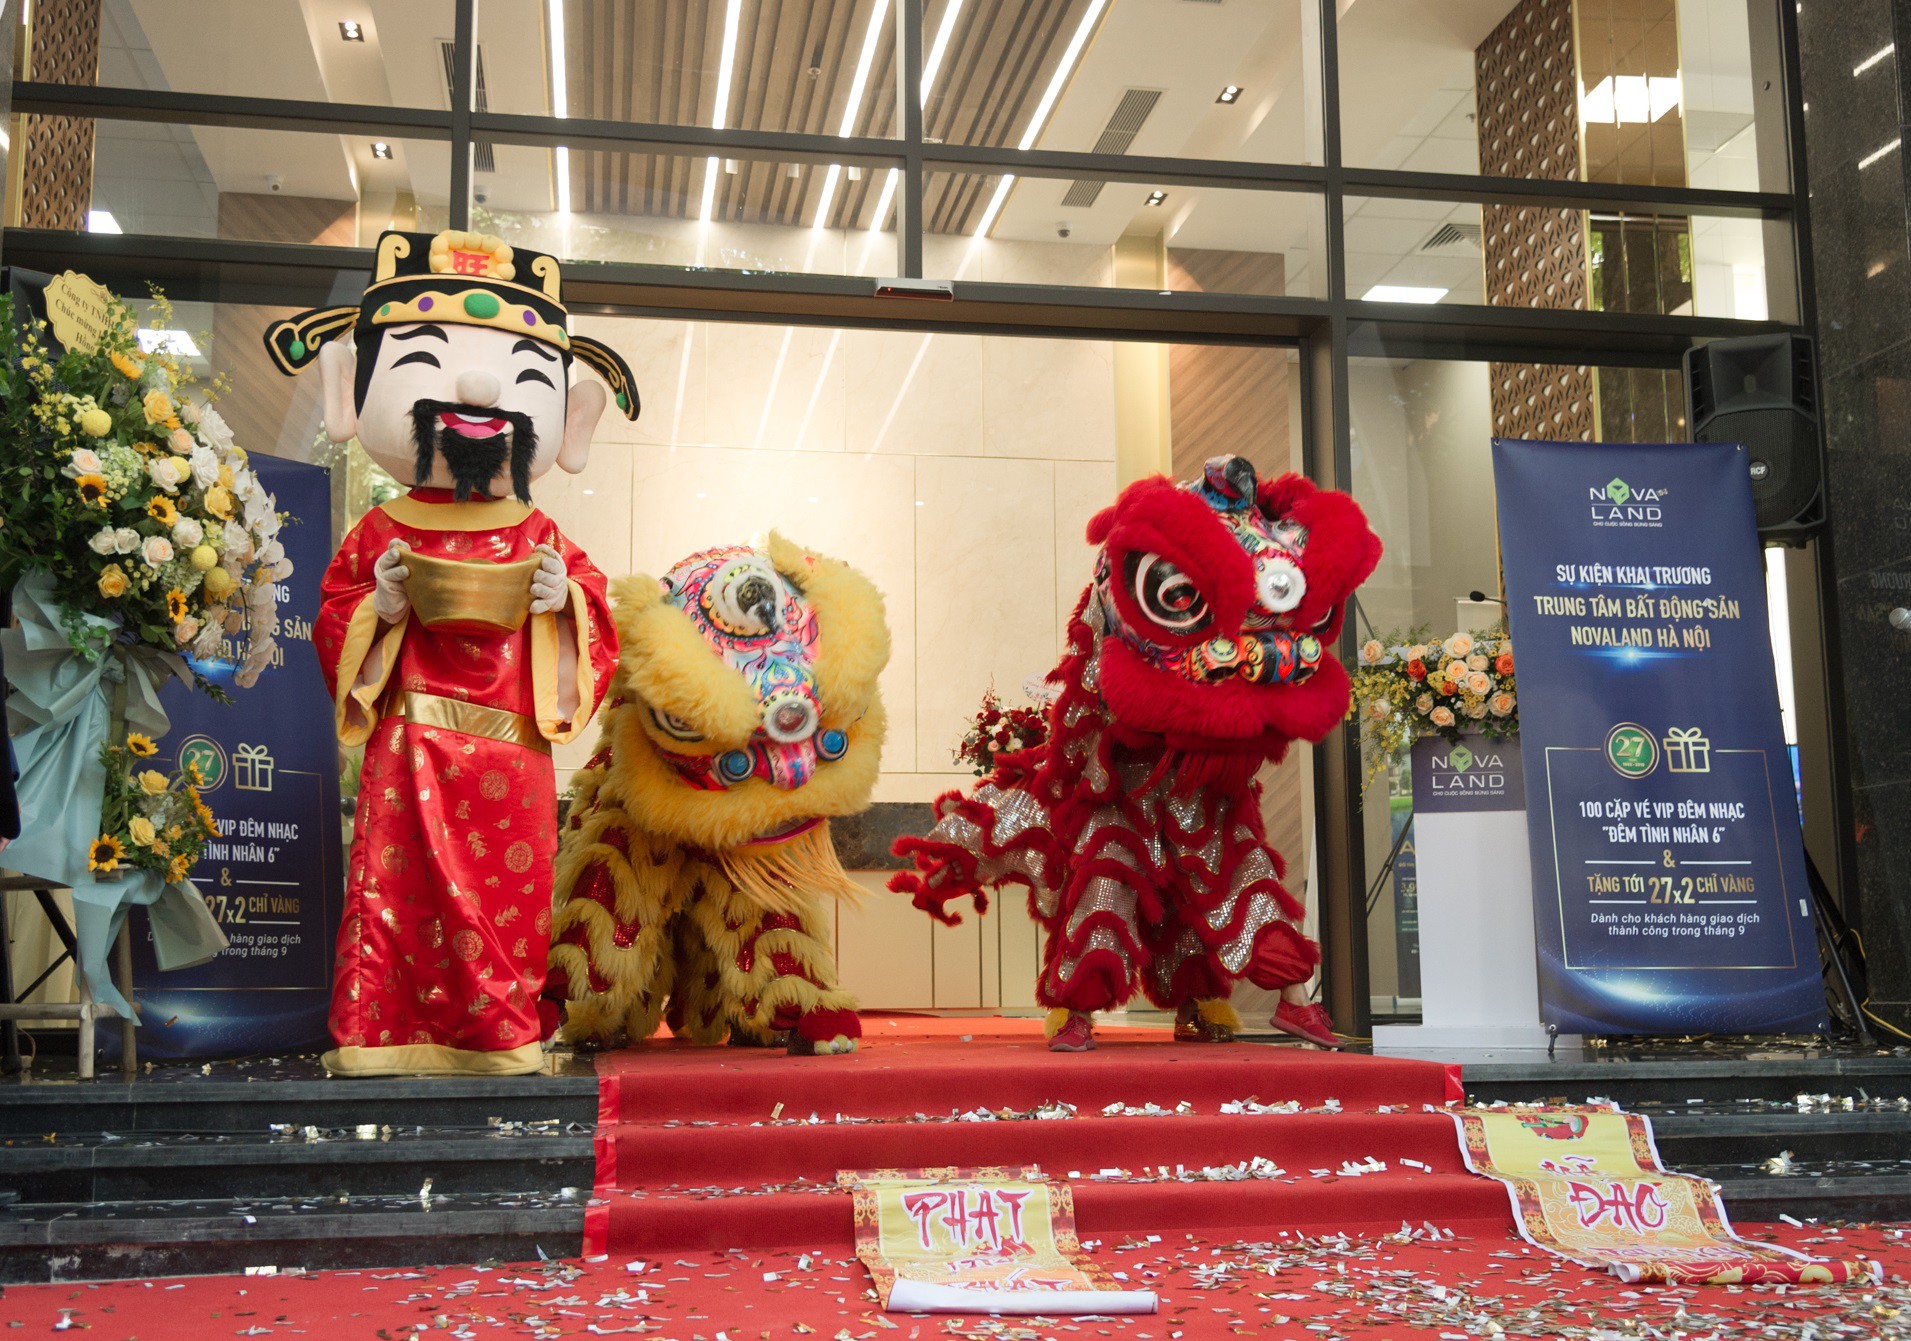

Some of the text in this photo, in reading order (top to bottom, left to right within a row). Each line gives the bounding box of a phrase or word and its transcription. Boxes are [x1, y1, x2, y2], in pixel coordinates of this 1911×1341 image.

[61, 283, 81, 308] Công
[55, 298, 98, 339] Chúc mừng
[1750, 466, 1766, 475] RCF
[1591, 506, 1662, 520] LAND
[1556, 562, 1712, 586] SỰ KIỆN KHAI TRƯƠNG
[1534, 594, 1740, 622] TRUNG TÂM BẤT ĐỘNG SẢN
[284, 615, 312, 641] SẢN
[1570, 625, 1711, 652] NOVALAND HÀ NỘI
[1615, 735, 1645, 758] 27
[186, 748, 216, 771] 27
[1432, 774, 1504, 789] LAND
[1579, 799, 1745, 822] 100 CẶP VÉ VIP ĐÊM NHẠC
[217, 818, 299, 842] VIP ĐÊM NHẠC
[1639, 823, 1670, 844] TÌNH
[1673, 823, 1709, 844] NHÂN
[232, 843, 265, 863] NHÂN
[1663, 849, 1676, 868] &
[220, 867, 232, 887] &
[1587, 872, 1755, 904] TẶNG TỚI 27x2 CHỈ VÀNG
[249, 893, 268, 914] CHỈ
[270, 895, 300, 914] VÀNG
[1591, 912, 1760, 926] Dành cho khách hàng giao dịch
[230, 933, 301, 946] hàng giao dịch
[1608, 924, 1745, 938] thành công trong tháng 9
[221, 946, 247, 958] trong
[250, 946, 278, 957] tháng
[281, 947, 287, 956] 9
